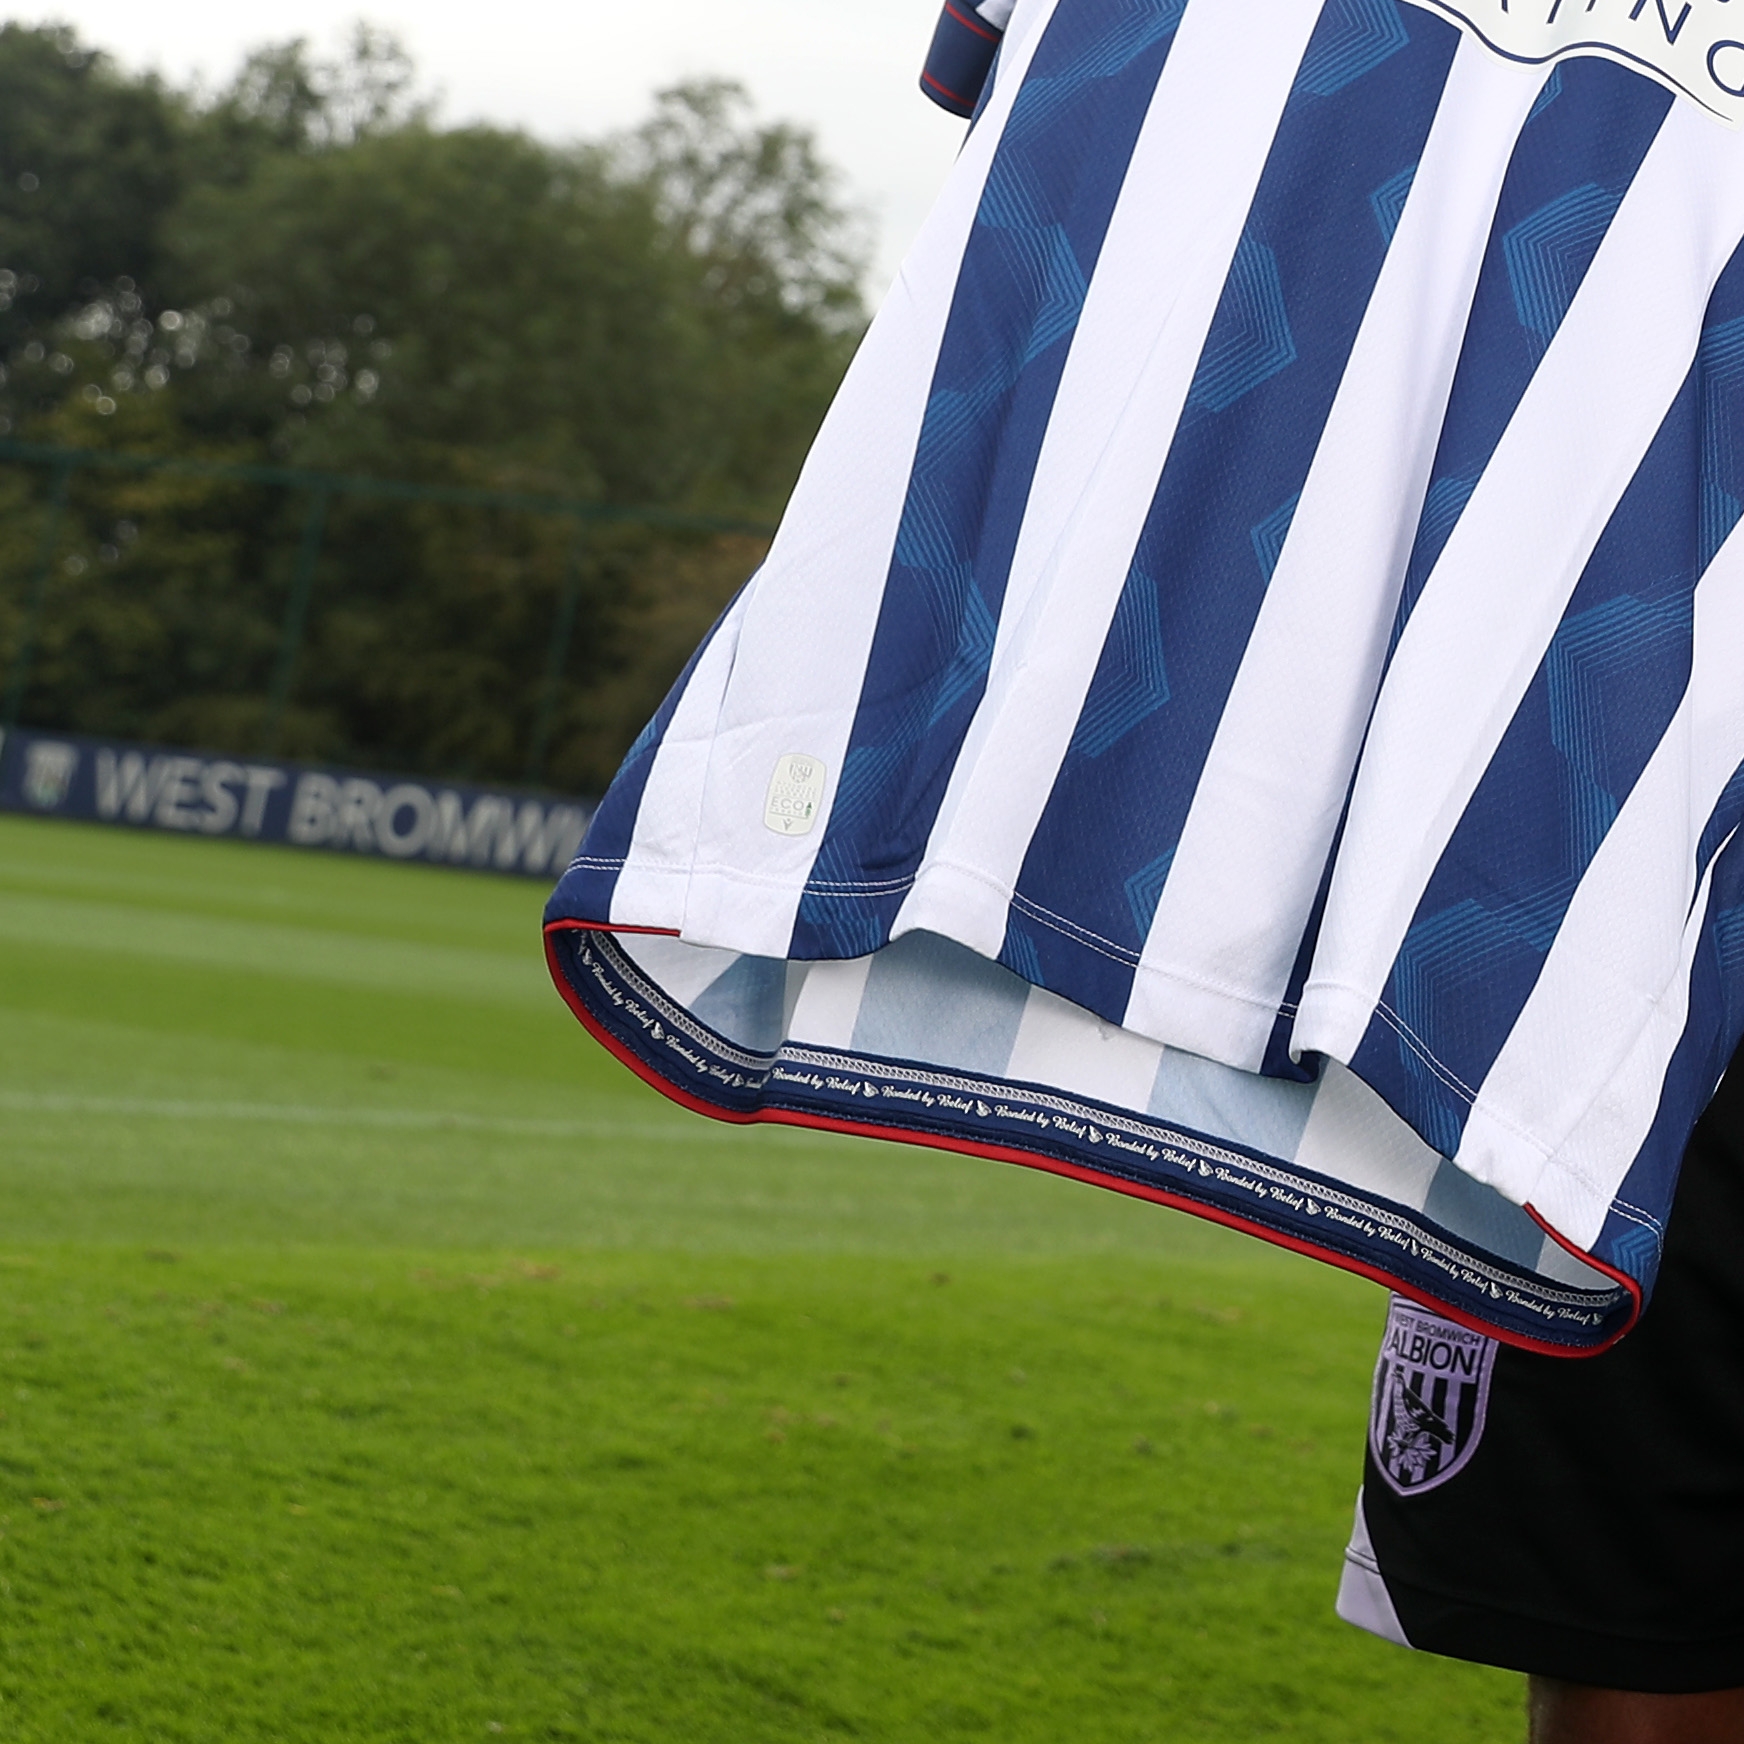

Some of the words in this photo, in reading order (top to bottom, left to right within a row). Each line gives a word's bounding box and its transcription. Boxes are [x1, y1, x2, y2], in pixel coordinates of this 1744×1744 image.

[94, 746, 287, 836] WEST
[771, 796, 805, 811] ECO
[772, 1067, 811, 1084] Bonded
[811, 1074, 824, 1090] by
[826, 1076, 861, 1095] Belief
[881, 1085, 921, 1101] Bonded
[921, 1091, 935, 1108] by
[937, 1094, 974, 1114] Belief
[994, 1105, 1036, 1122] Bonded
[1036, 1112, 1050, 1129] by
[1052, 1115, 1087, 1139] Belief
[1105, 1132, 1147, 1155] Bonded
[1146, 1144, 1160, 1161] by
[1161, 1148, 1197, 1173] Belief
[1215, 1167, 1256, 1190] Bonded
[1254, 1182, 1268, 1198] by
[1270, 1186, 1304, 1211] Belief
[1324, 1205, 1365, 1229] Bonded
[1363, 1221, 1376, 1237] by
[1378, 1226, 1410, 1250] Belief
[1421, 1247, 1452, 1272] Bonded
[1449, 1264, 1460, 1280] by
[1461, 1268, 1489, 1294] Belief
[1506, 1289, 1544, 1313] Bonded
[1543, 1305, 1556, 1320] by
[1557, 1307, 1591, 1326] Belief
[1387, 1328, 1476, 1376] ALBION
[1416, 1321, 1481, 1346] BROMWICH
